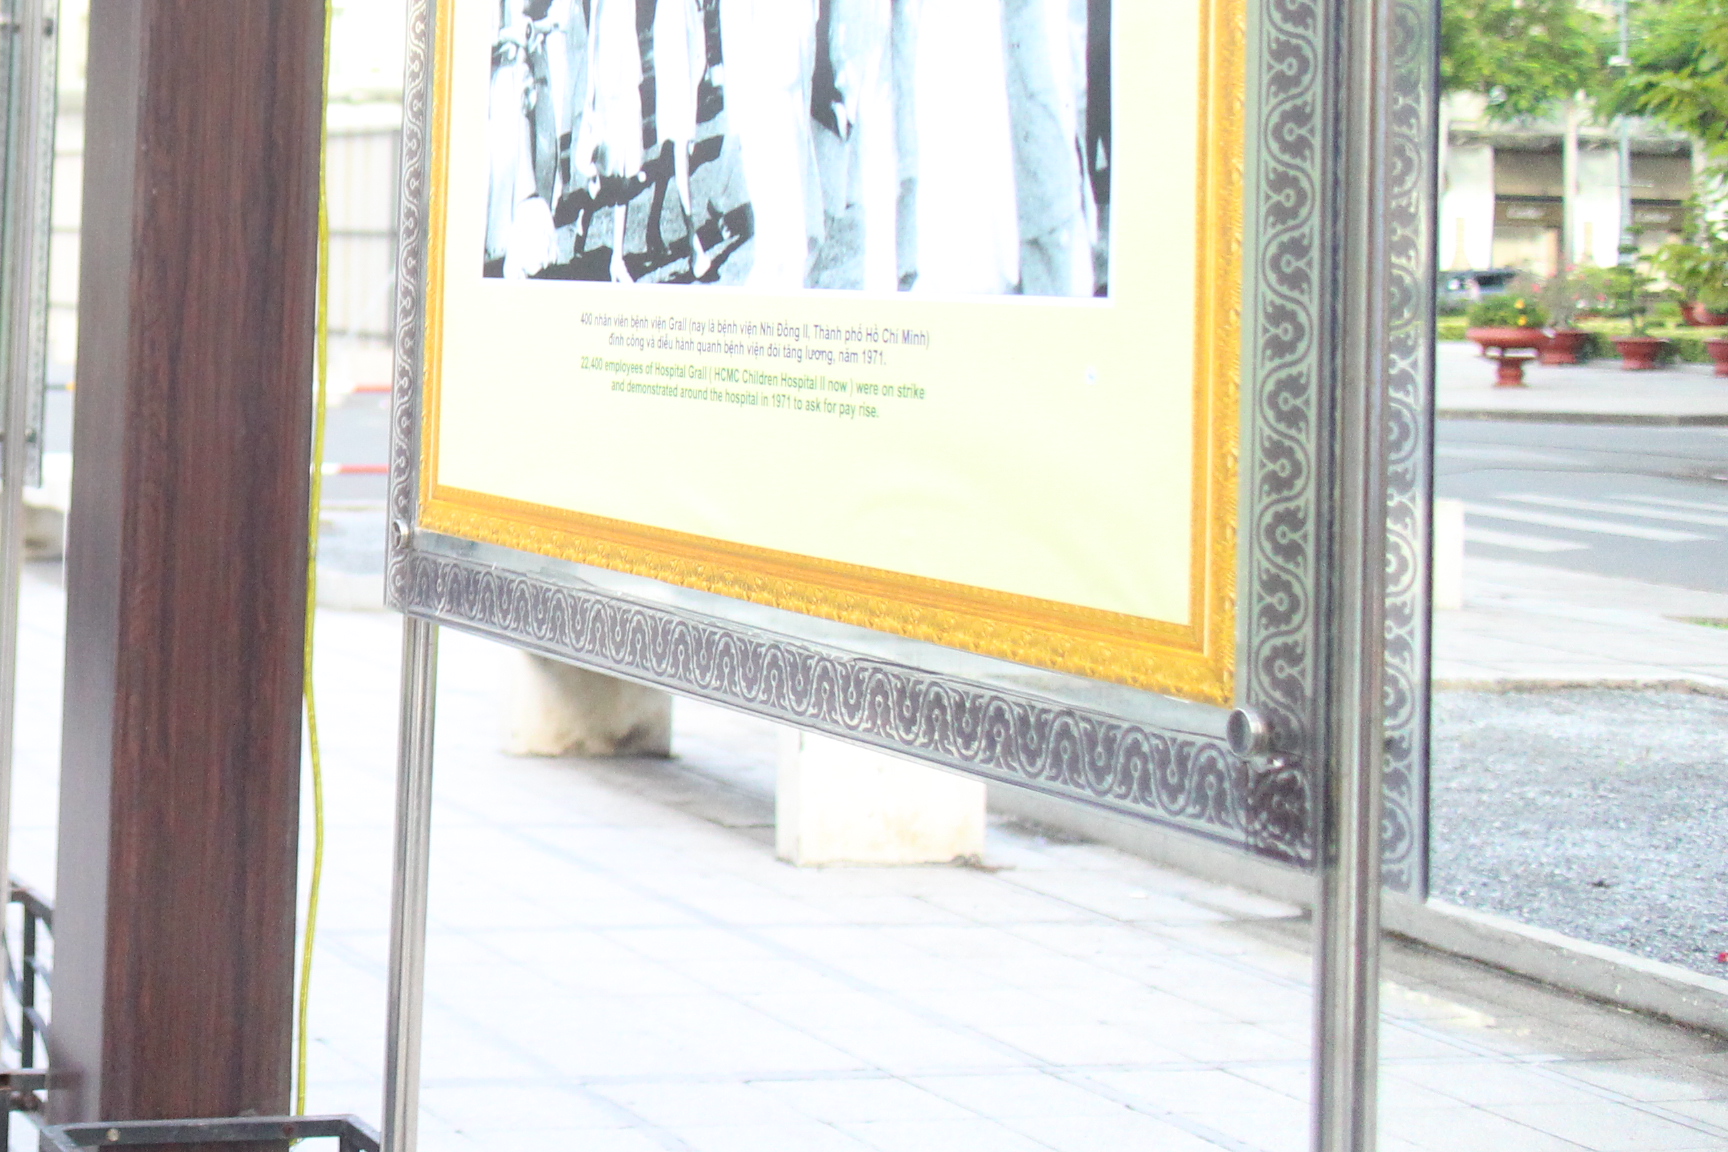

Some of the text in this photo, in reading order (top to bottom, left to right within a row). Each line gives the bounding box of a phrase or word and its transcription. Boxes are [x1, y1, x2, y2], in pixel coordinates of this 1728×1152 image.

[580, 312, 592, 325] 400
[668, 317, 687, 331] Grall
[689, 317, 706, 336] (nay
[759, 321, 775, 336] Nhi
[813, 324, 842, 341] Thành
[901, 329, 930, 350] Minh)
[696, 339, 722, 355] quanh
[862, 349, 886, 366] 1971.
[605, 359, 643, 377] employees
[645, 361, 653, 375] of
[655, 362, 686, 380] Hospital
[688, 365, 707, 380] Grall
[742, 369, 778, 387] Children
[780, 373, 818, 392] Hospital
[827, 380, 848, 393] now
[856, 382, 879, 396] were
[881, 384, 894, 397] on
[897, 382, 925, 400] strike
[611, 379, 624, 392] and
[626, 379, 678, 398] demonstrated
[680, 386, 708, 401] around
[710, 387, 723, 402] the
[725, 389, 758, 408] hospital
[761, 391, 769, 407] in
[772, 393, 791, 409] 1971
[793, 396, 803, 410] to
[805, 397, 822, 412] ask
[823, 397, 837, 414] for
[839, 402, 857, 420] pay
